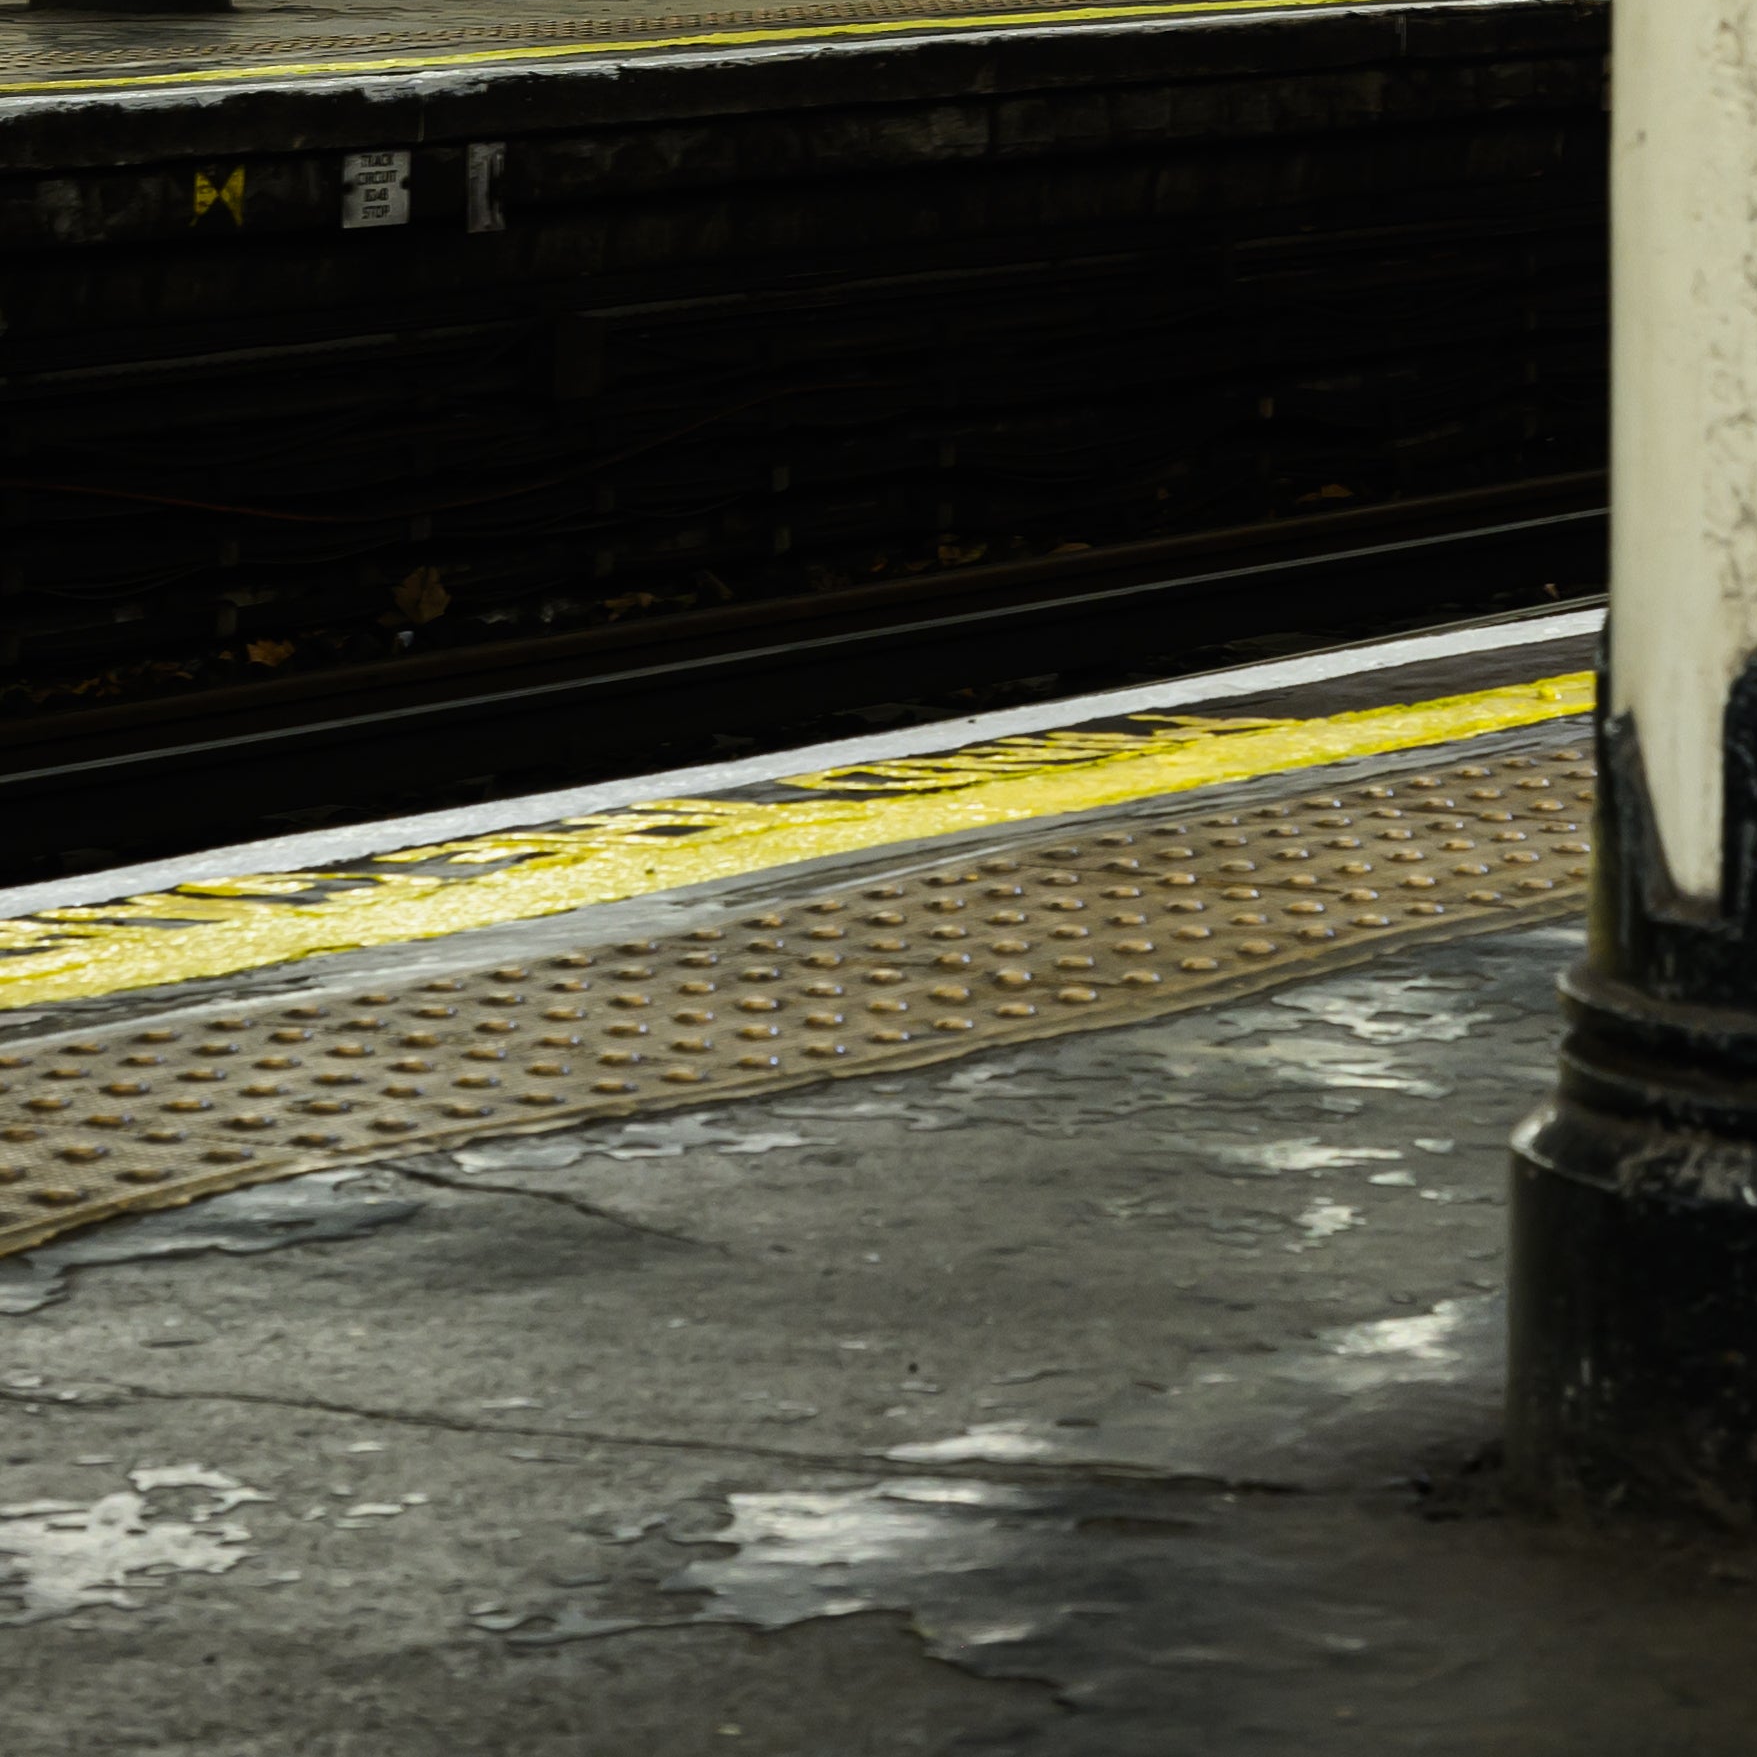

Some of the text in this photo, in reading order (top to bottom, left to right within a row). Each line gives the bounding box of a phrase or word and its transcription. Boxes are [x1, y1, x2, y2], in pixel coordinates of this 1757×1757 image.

[361, 153, 394, 167] TRACK
[356, 170, 398, 185] CIRCUIT
[361, 205, 390, 219] STOP
